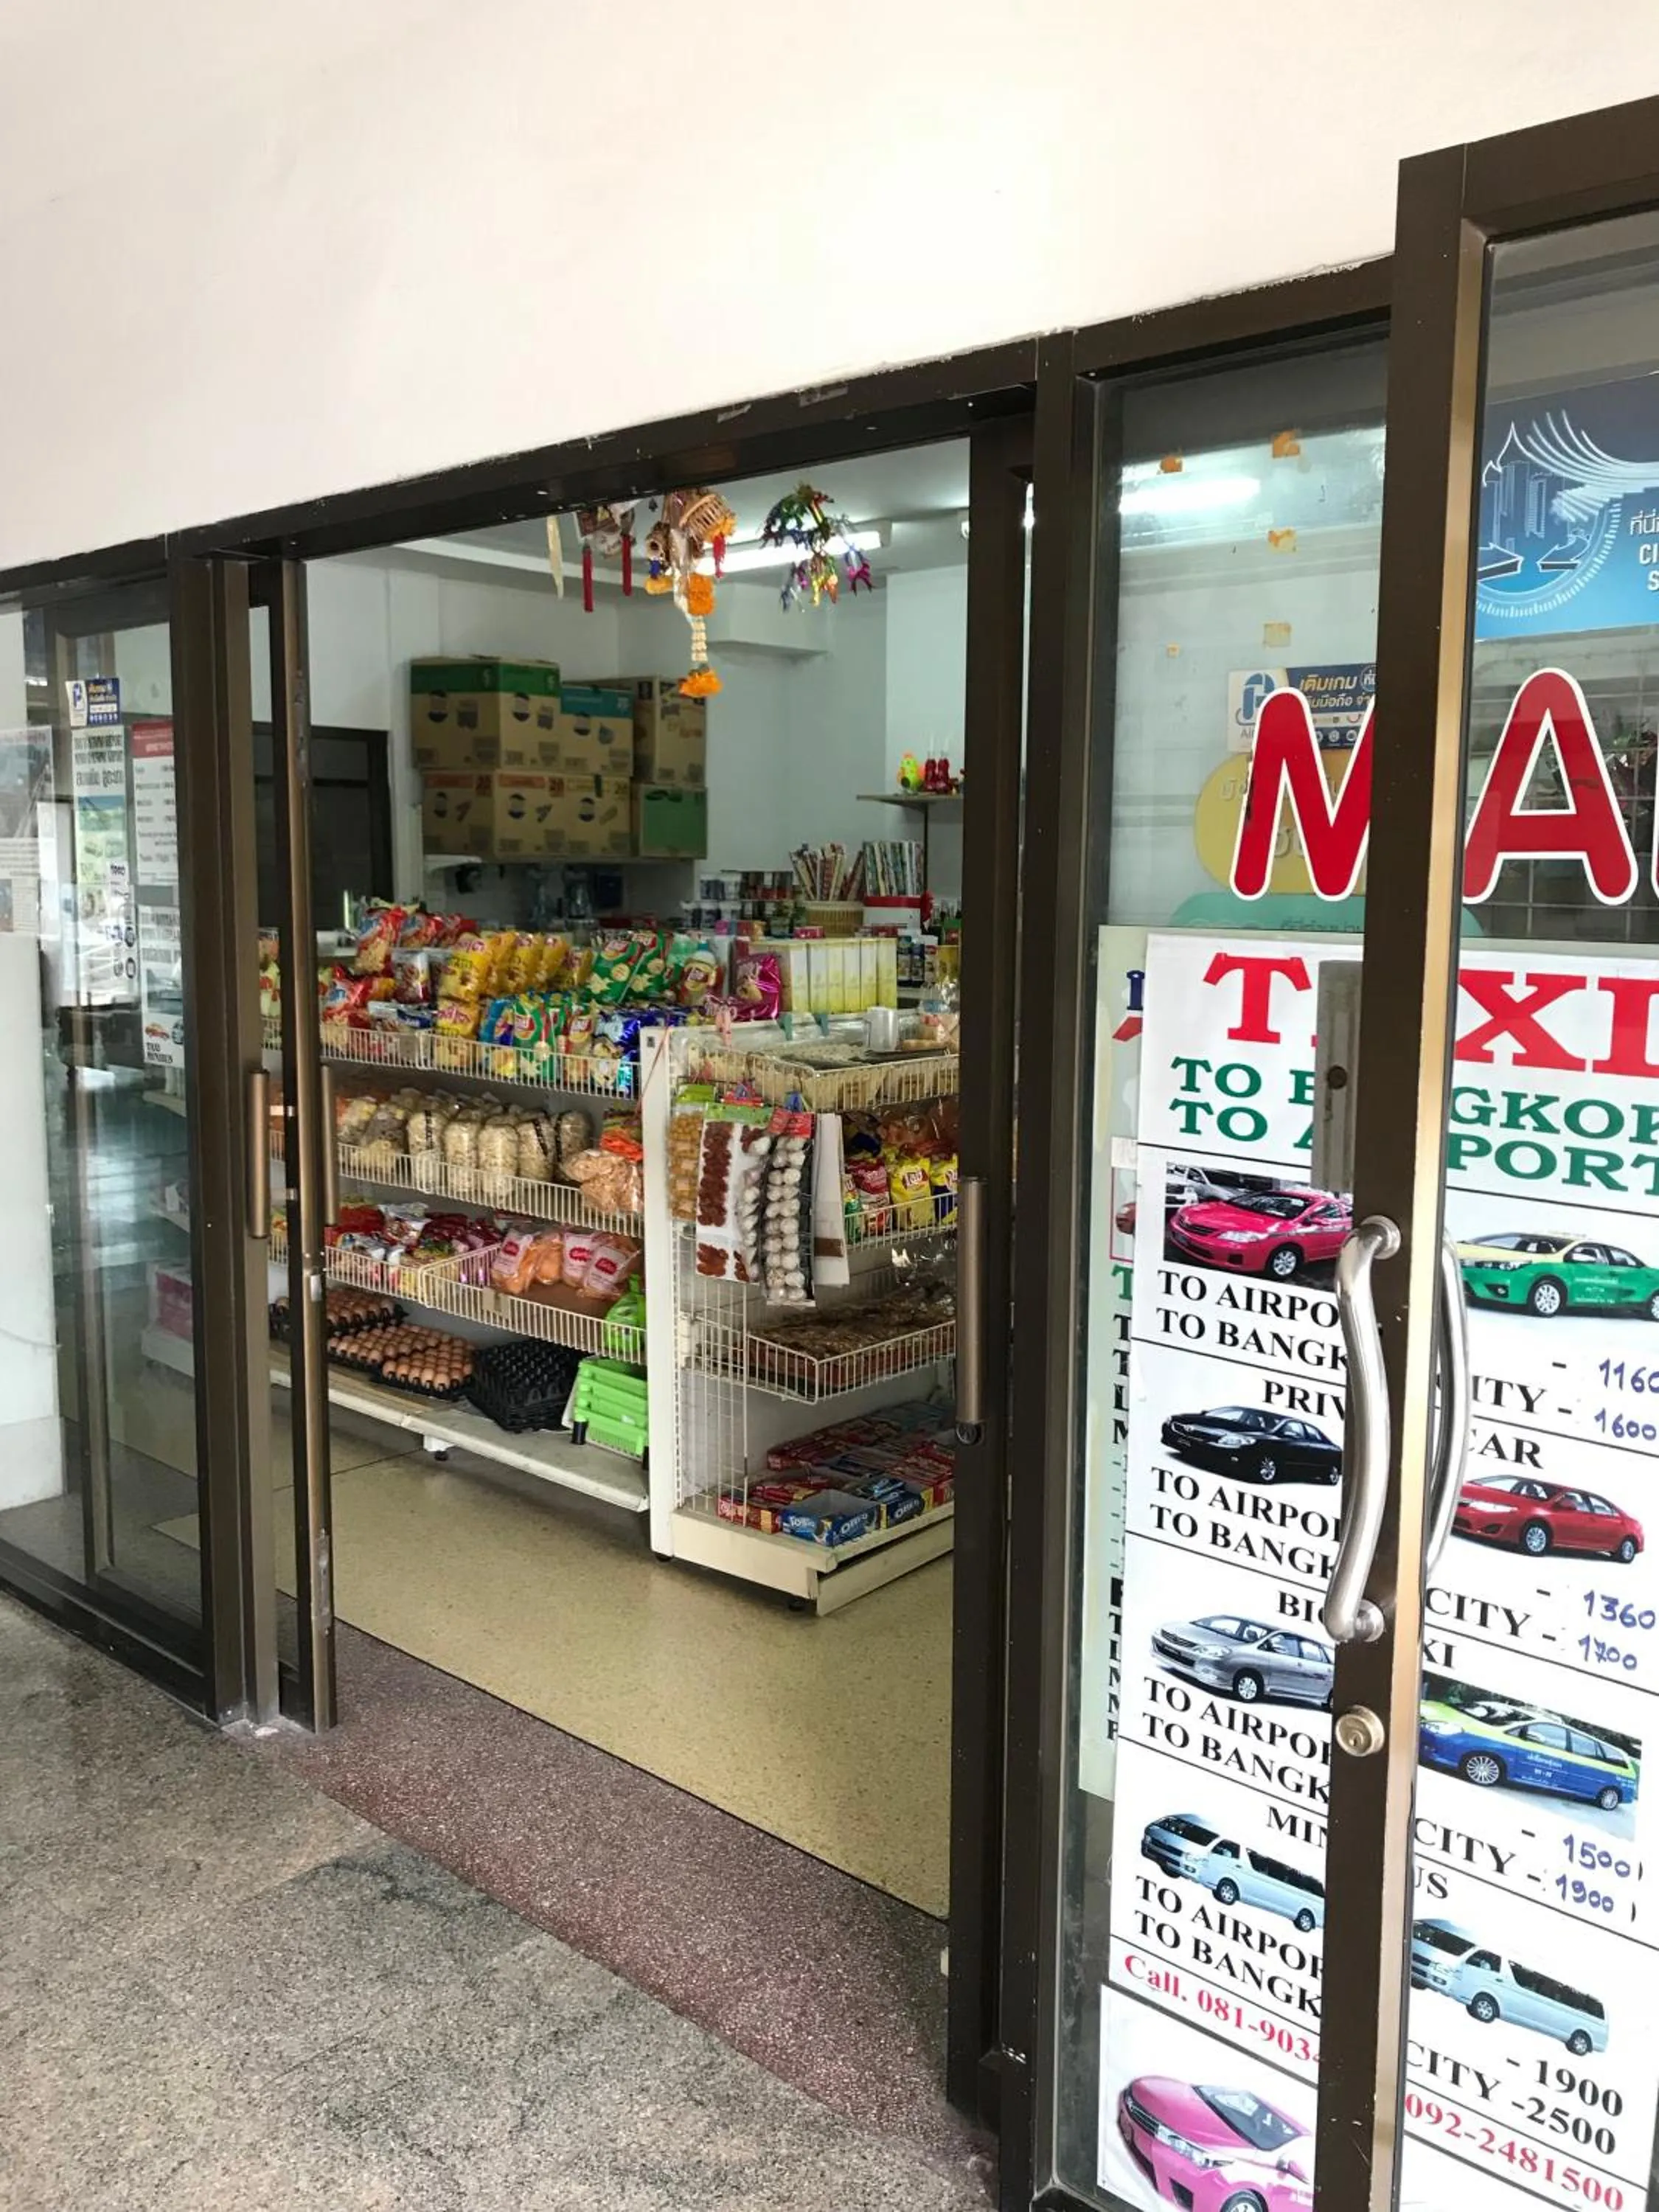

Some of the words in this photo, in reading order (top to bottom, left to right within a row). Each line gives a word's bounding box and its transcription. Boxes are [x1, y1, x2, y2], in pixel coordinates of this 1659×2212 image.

[1169, 1098, 1268, 1141] TO
[1170, 1056, 1262, 1098] TO
[1157, 1269, 1207, 1301] TO
[1215, 1282, 1340, 1328] AIRPO
[1156, 1307, 1206, 1339] TO
[1217, 1319, 1348, 1370] BANGK
[1436, 1374, 1546, 1414] ITY
[1594, 1408, 1657, 1441] 1600
[1262, 1378, 1346, 1422] PRIV
[1150, 1503, 1198, 1538] TO
[1209, 1520, 1333, 1579] BANGK
[1425, 1587, 1532, 1638] CITY
[1151, 1467, 1200, 1500] TO
[1208, 1485, 1341, 1543] AIRPO
[1583, 1589, 1656, 1630] 1360
[1276, 1590, 1325, 1624] BI
[1142, 1712, 1190, 1748] TO
[1200, 1733, 1330, 1805] BANGK
[1414, 1817, 1517, 1876] CITY
[1555, 1874, 1615, 1913] 1900
[1144, 1676, 1192, 1713] TO
[1200, 1700, 1330, 1766] AIRPO
[1562, 1832, 1631, 1878] 1500
[1133, 1910, 1181, 1949] TO
[1192, 1936, 1322, 2019] BANGK
[1135, 1875, 1183, 1914] TO
[1191, 1904, 1324, 1981] AIRPOR
[1535, 2059, 1623, 2117] 1900
[1124, 1955, 1188, 2002] Call.
[1197, 1989, 1323, 2064] 081-903
[1405, 2093, 1624, 2212] 092-2481500
